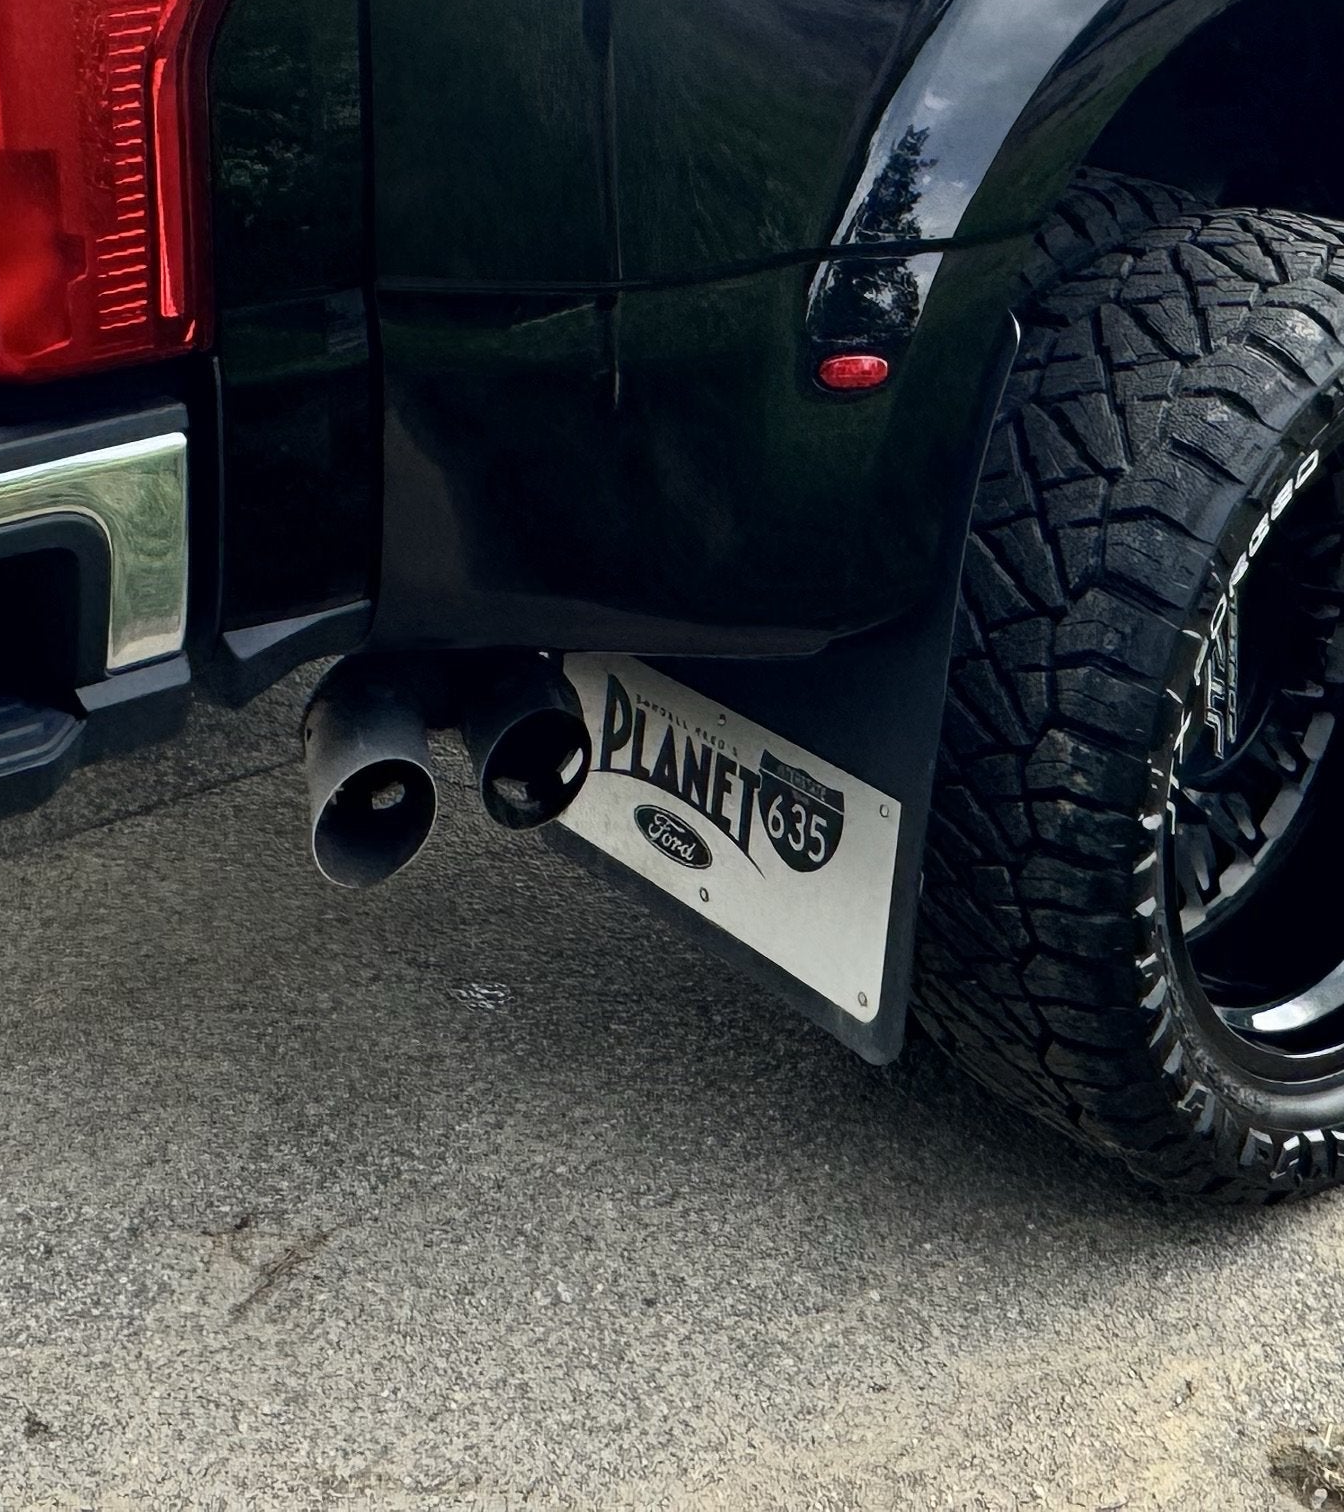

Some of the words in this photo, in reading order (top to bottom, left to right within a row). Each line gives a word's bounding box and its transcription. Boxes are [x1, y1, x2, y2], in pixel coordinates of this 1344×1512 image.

[600, 672, 762, 855] PLANET
[648, 813, 697, 862] Ford
[767, 794, 828, 863] 635
